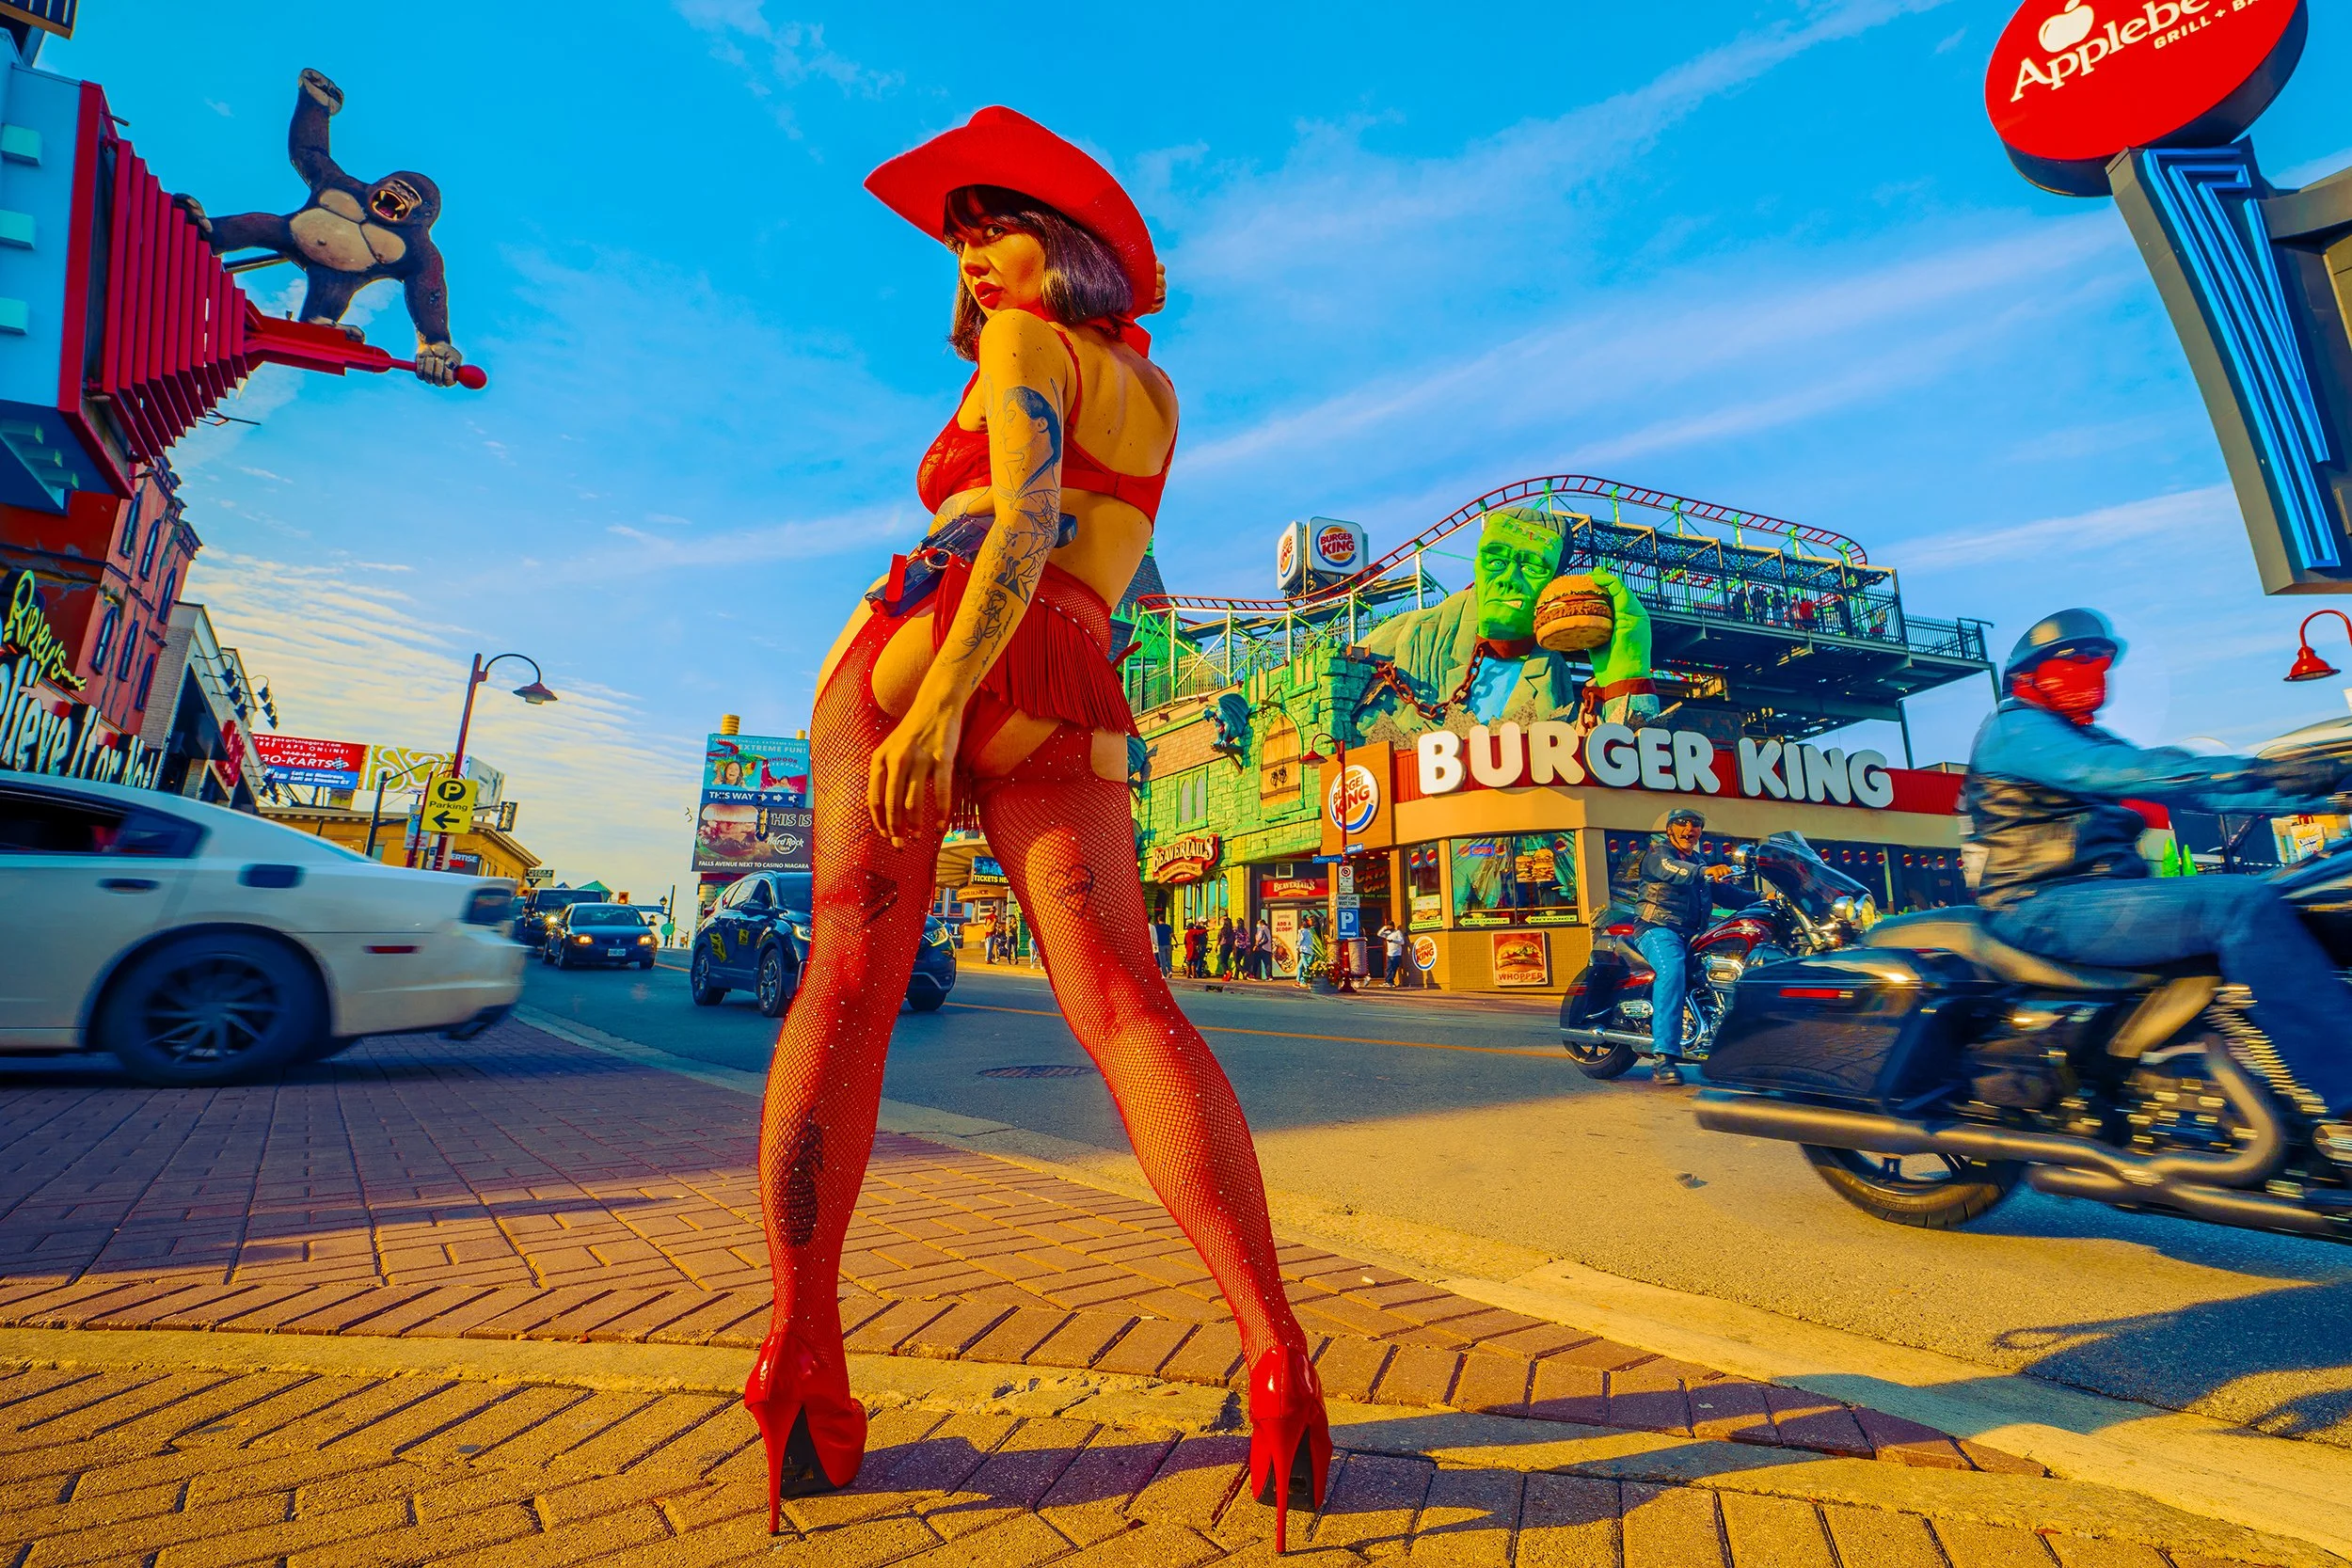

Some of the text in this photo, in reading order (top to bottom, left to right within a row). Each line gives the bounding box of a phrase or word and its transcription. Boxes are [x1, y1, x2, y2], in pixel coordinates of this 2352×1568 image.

[2153, 16, 2212, 49] GRILL
[1320, 532, 1353, 545] BURGER
[1322, 541, 1355, 557] KING
[739, 744, 781, 752] EXTREME
[1418, 721, 1895, 809] BURGER KING
[443, 783, 462, 799] P
[429, 800, 469, 812] Parking
[799, 814, 812, 827] IS
[787, 837, 804, 847] Rock
[452, 852, 479, 863] ERTISE
[974, 875, 998, 883] TICKETS
[1341, 911, 1355, 929] P
[1415, 942, 1433, 955] BURGER
[1416, 949, 1434, 962] KING
[1498, 973, 1544, 981] WHOPPER
